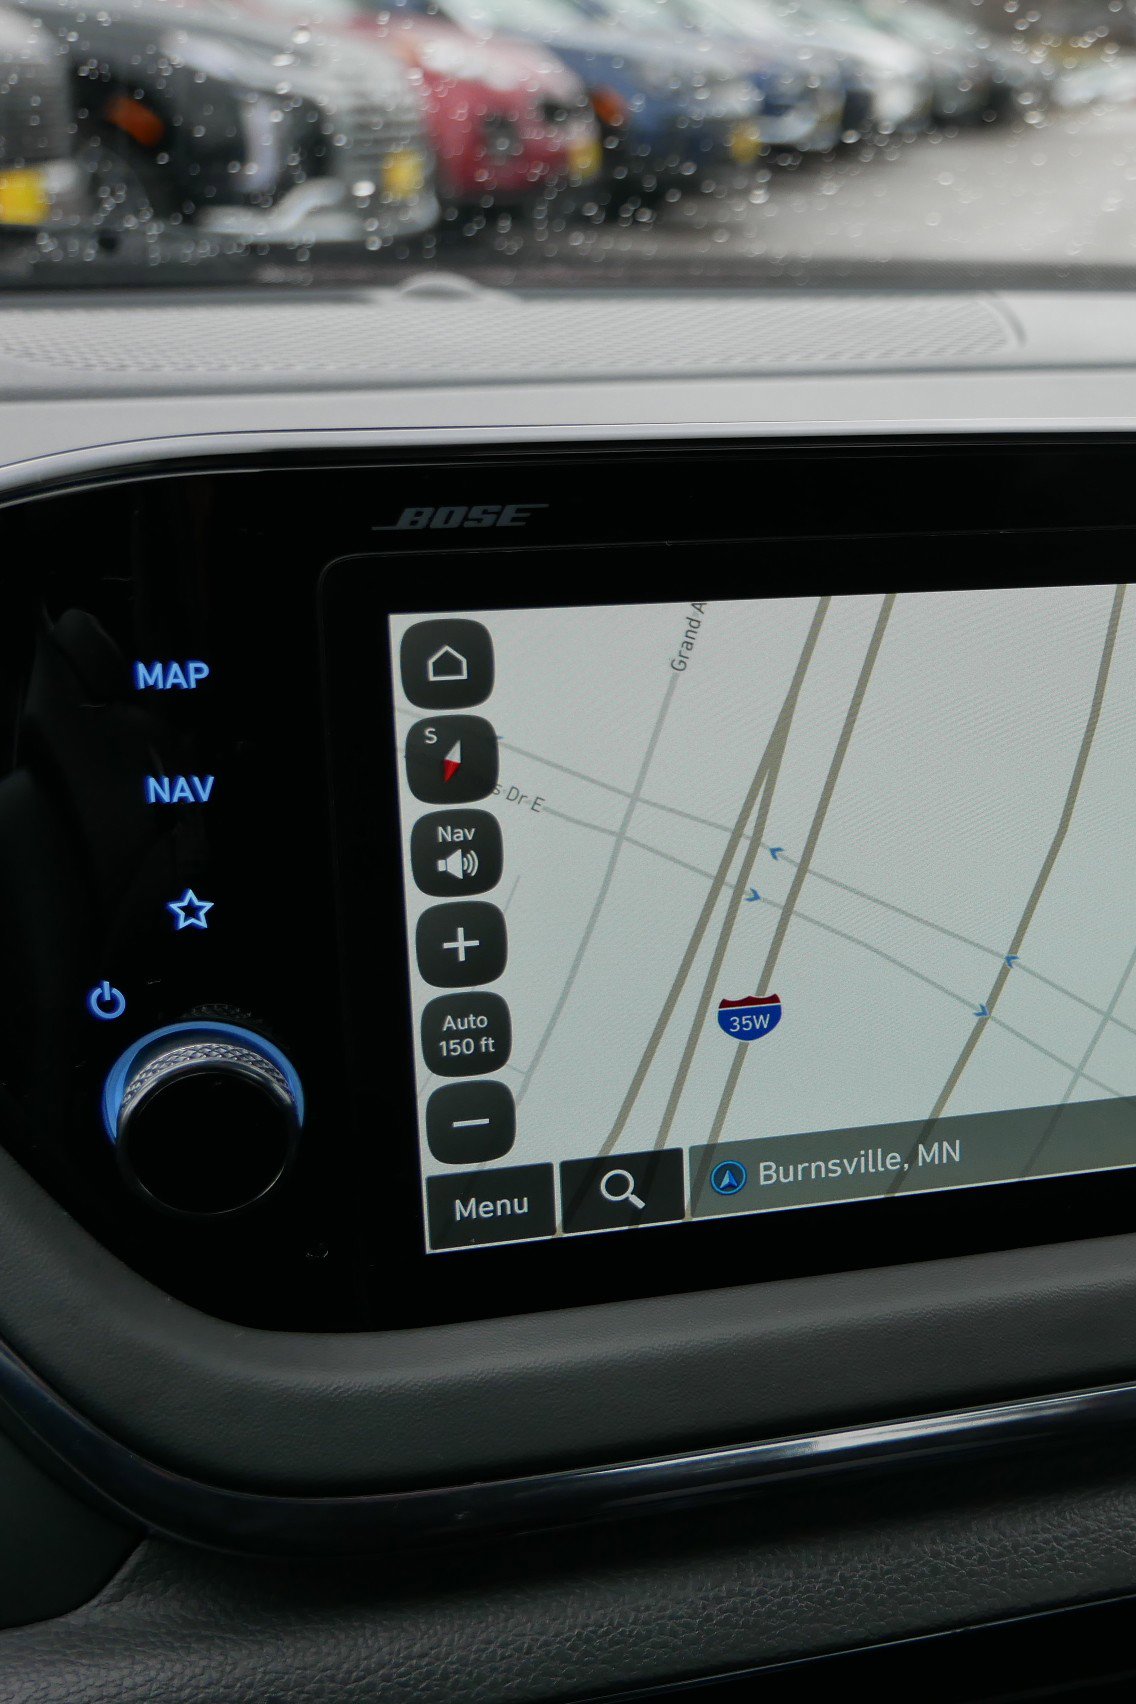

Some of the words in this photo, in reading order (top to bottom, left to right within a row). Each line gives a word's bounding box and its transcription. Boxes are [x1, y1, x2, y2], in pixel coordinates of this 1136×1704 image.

[372, 503, 549, 530] BOSE
[669, 616, 702, 673] Grand
[134, 660, 210, 690] MAP
[424, 726, 438, 745] S
[145, 776, 215, 804] NAV
[506, 785, 528, 805] Dr
[530, 796, 546, 813] E
[437, 826, 476, 843] Nav
[442, 1014, 489, 1032] Auto
[729, 1013, 771, 1033] 35W
[438, 1037, 475, 1057] 150
[480, 1036, 496, 1053] ft
[758, 1147, 909, 1187] Burnsville,
[917, 1139, 961, 1168] MN
[454, 1195, 529, 1222] Menu
